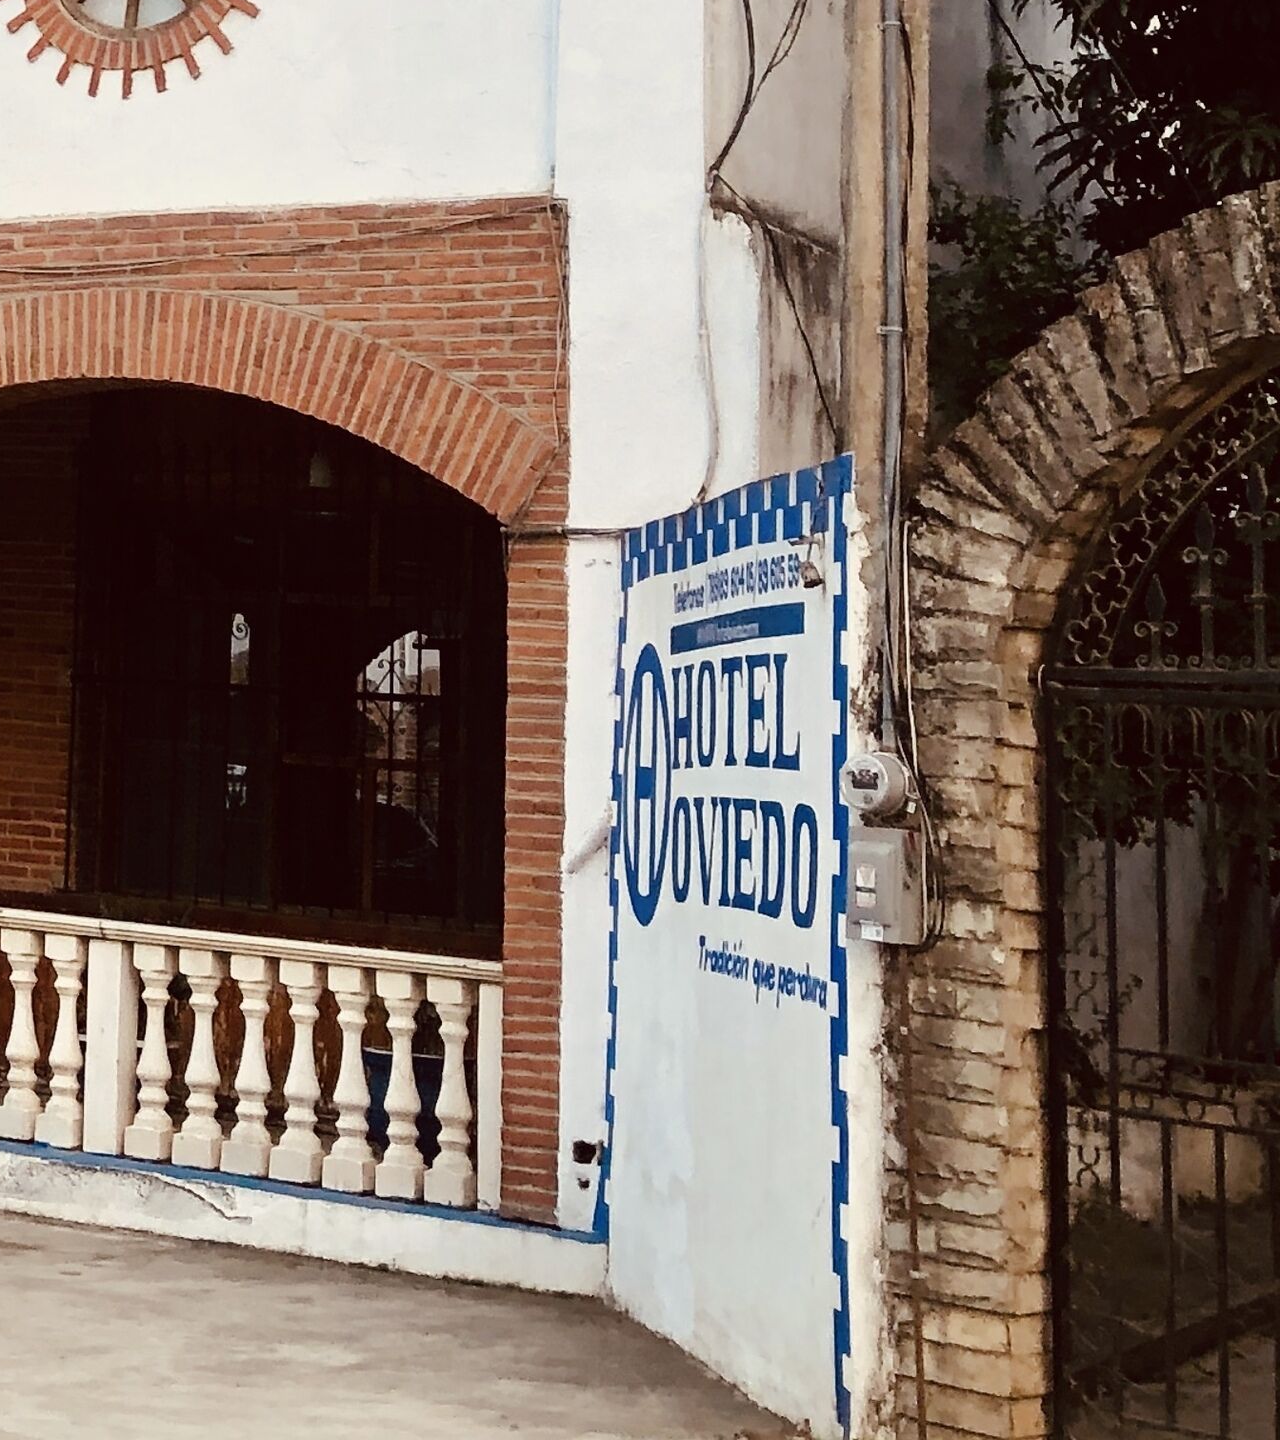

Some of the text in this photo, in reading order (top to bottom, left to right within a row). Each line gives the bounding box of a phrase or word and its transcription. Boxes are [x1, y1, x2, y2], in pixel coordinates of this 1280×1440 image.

[671, 653, 801, 771] HOTEL
[671, 796, 819, 928] OVIEDO
[699, 935, 828, 1010] Tradición que perdura
